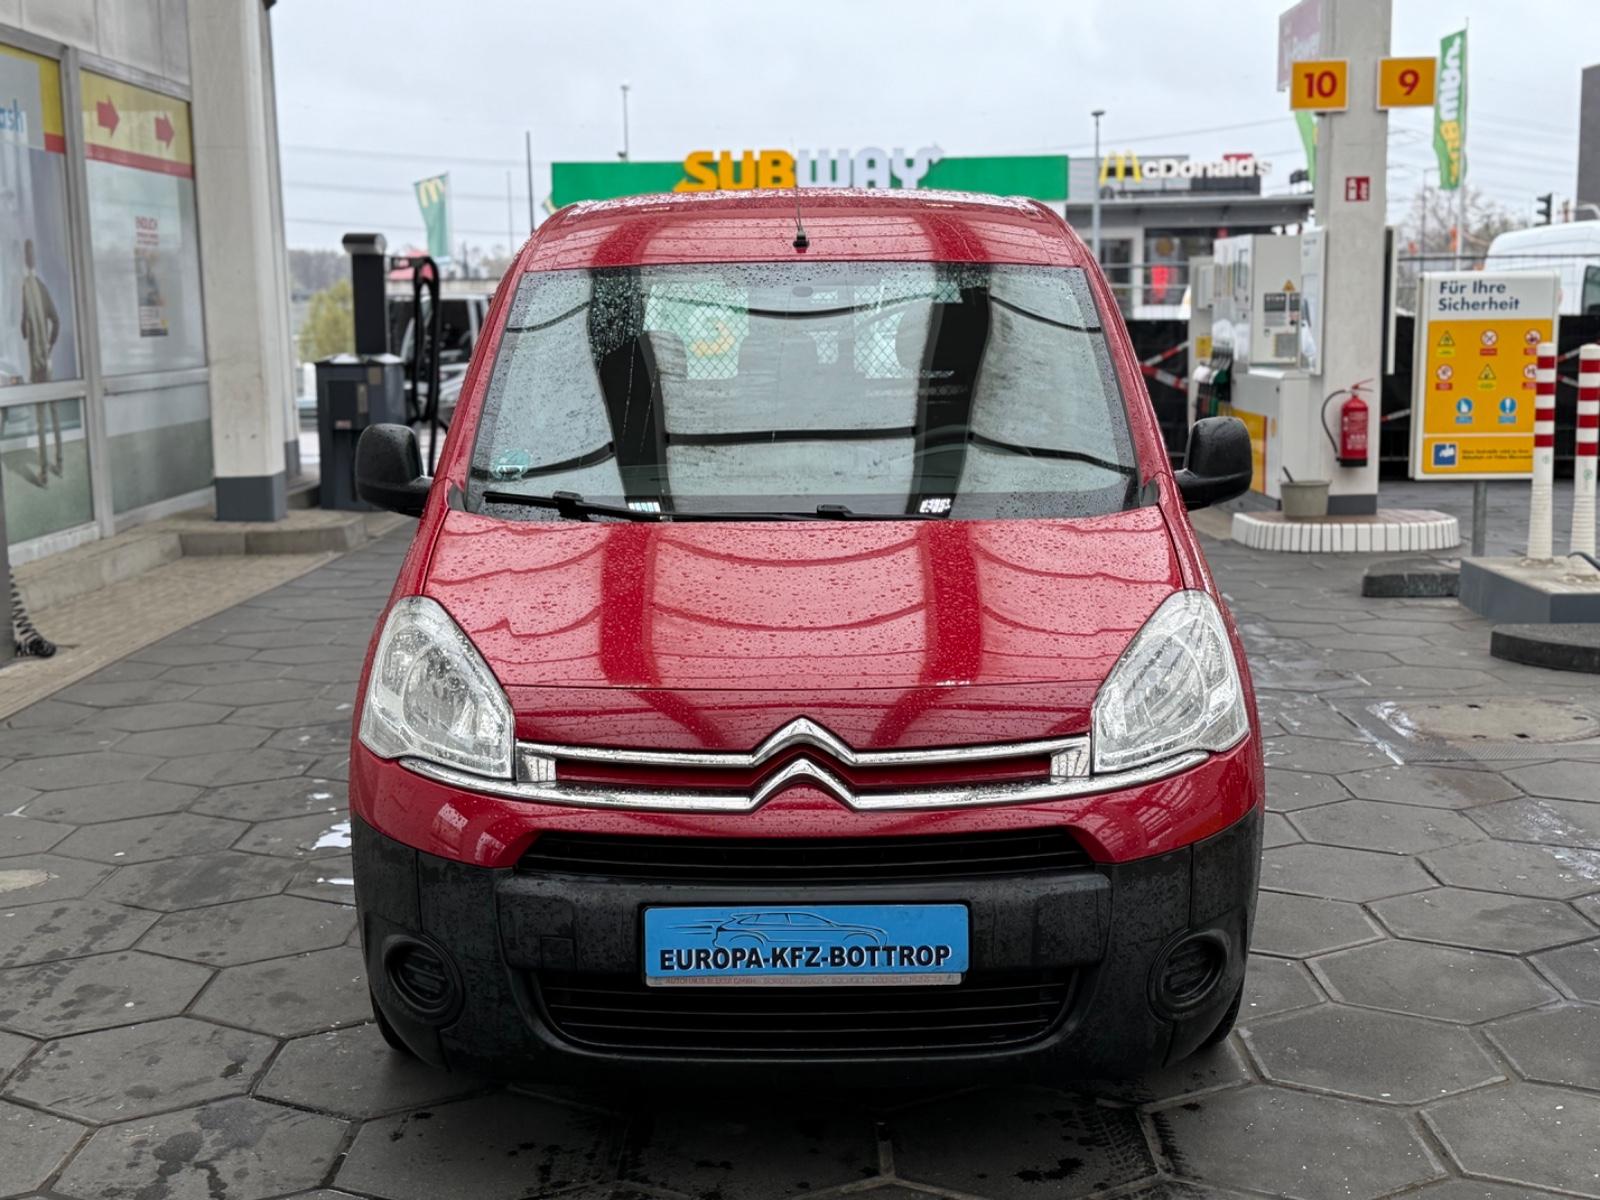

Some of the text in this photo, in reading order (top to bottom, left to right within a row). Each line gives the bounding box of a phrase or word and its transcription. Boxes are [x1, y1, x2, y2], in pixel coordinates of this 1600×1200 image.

[1304, 70, 1337, 98] 10
[1398, 69, 1420, 96] 9
[672, 149, 945, 192] SUBWAY
[1440, 279, 1506, 294] Für Ihre
[1438, 297, 1520, 311] Sicherheit
[660, 945, 952, 970] EUROPA-KFZ-BOTTROP
